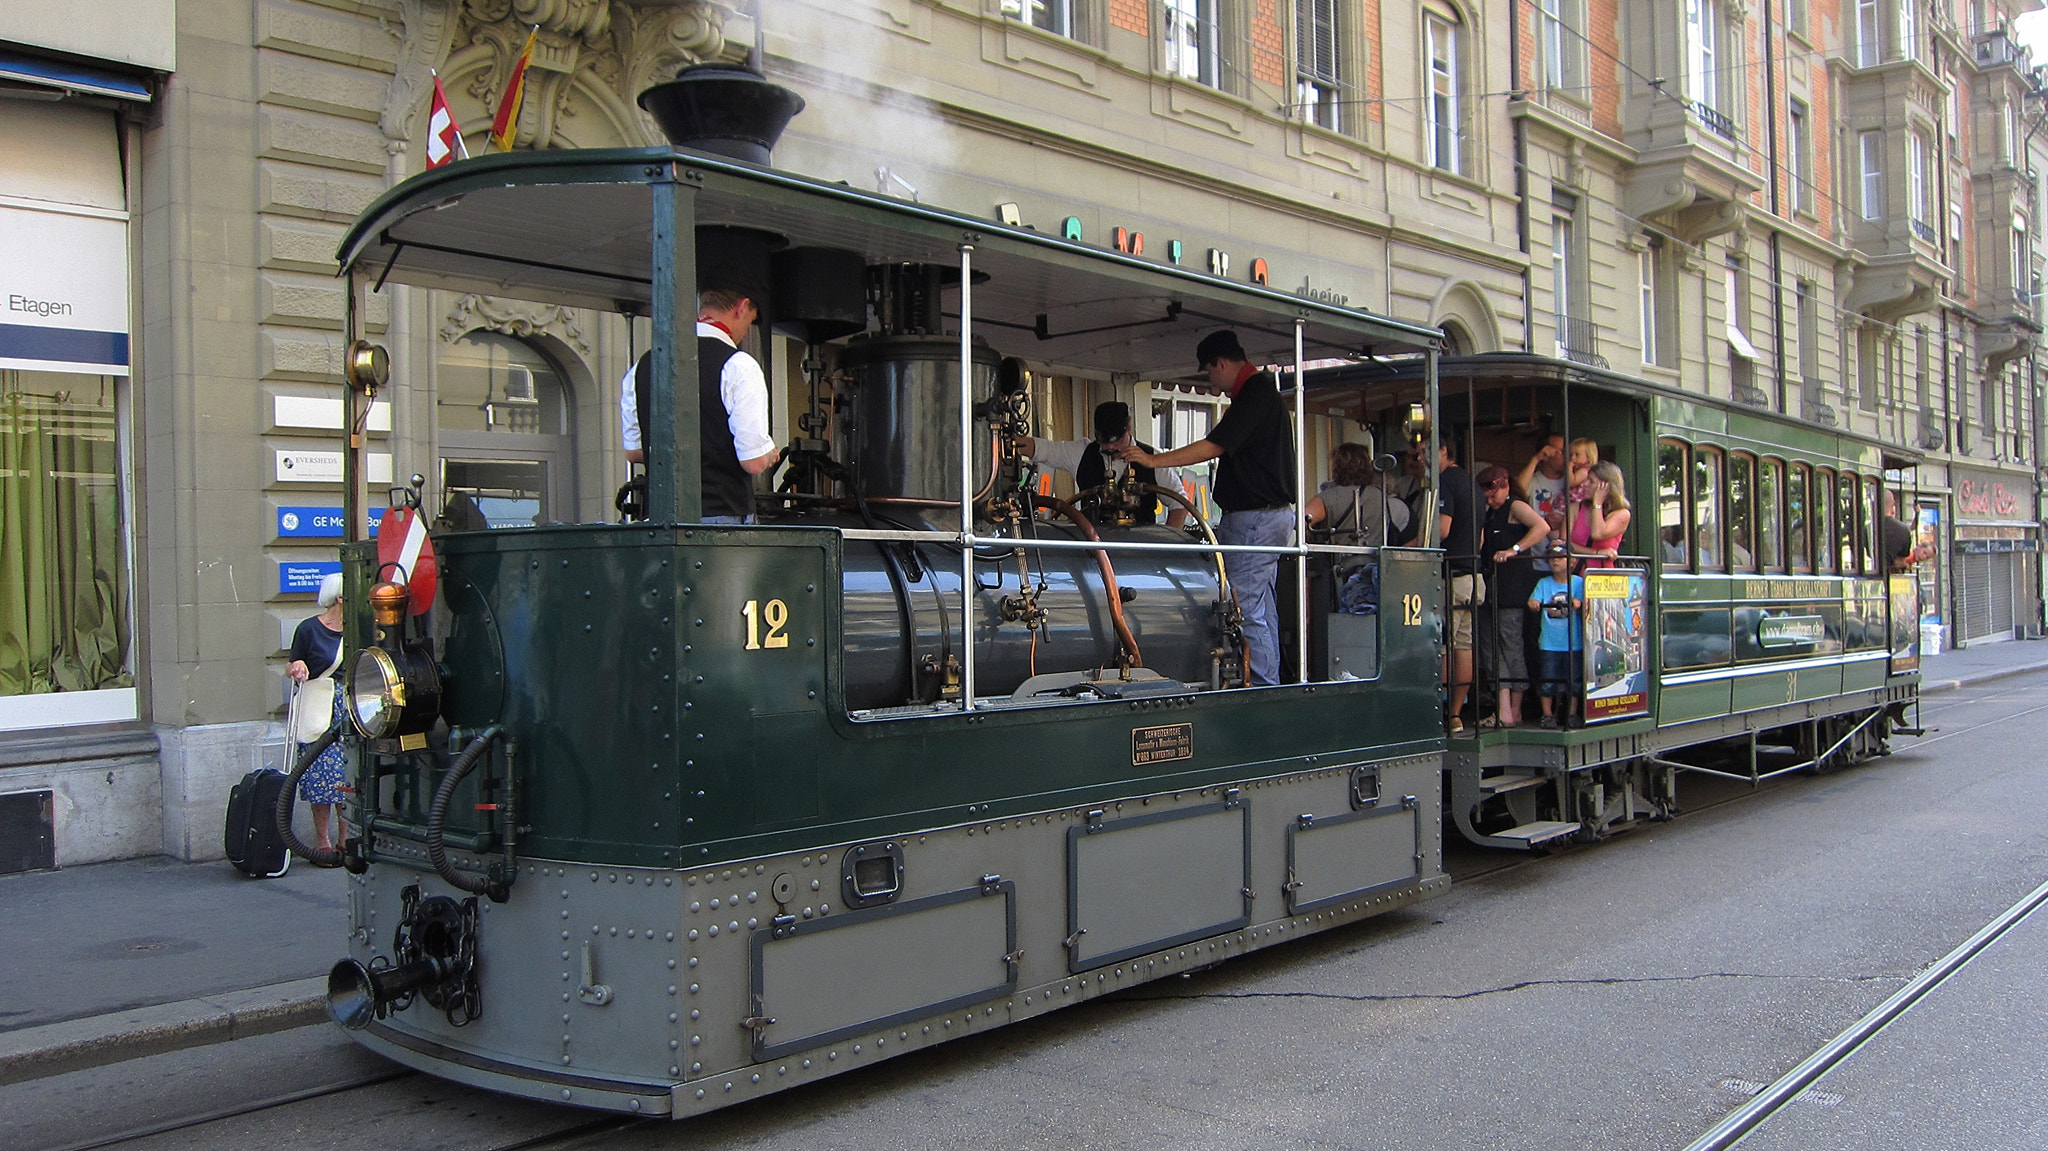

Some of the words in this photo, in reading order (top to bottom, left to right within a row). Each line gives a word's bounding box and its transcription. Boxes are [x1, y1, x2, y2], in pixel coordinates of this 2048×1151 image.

[9, 294, 72, 317] Etagen
[295, 456, 338, 464] EVERSHEDS
[313, 516, 327, 527] GE
[1586, 578, 1603, 592] Come
[1402, 594, 1422, 626] 12
[741, 599, 788, 650] 12
[1786, 671, 1798, 702] 31
[1144, 728, 1180, 738] SCHWEIZERISCHE
